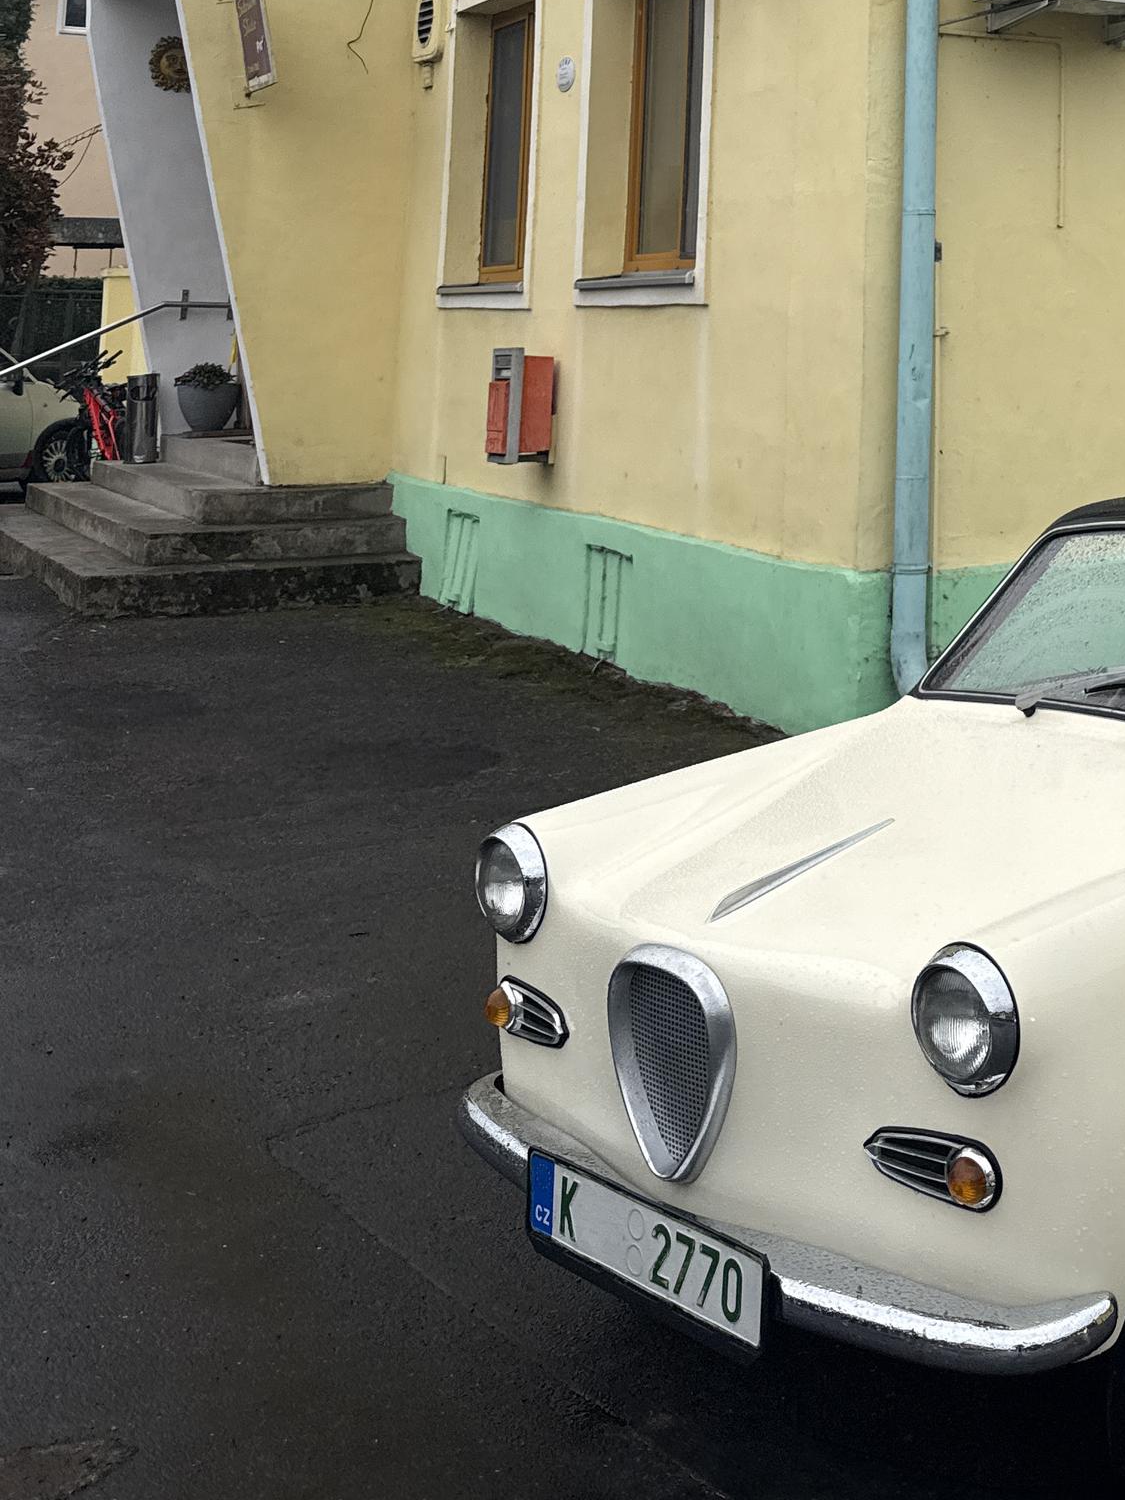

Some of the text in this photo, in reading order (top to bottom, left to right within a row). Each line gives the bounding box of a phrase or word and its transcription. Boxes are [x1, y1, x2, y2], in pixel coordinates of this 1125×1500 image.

[535, 1204, 550, 1225] CZ
[559, 1175, 742, 1323] K 2770
